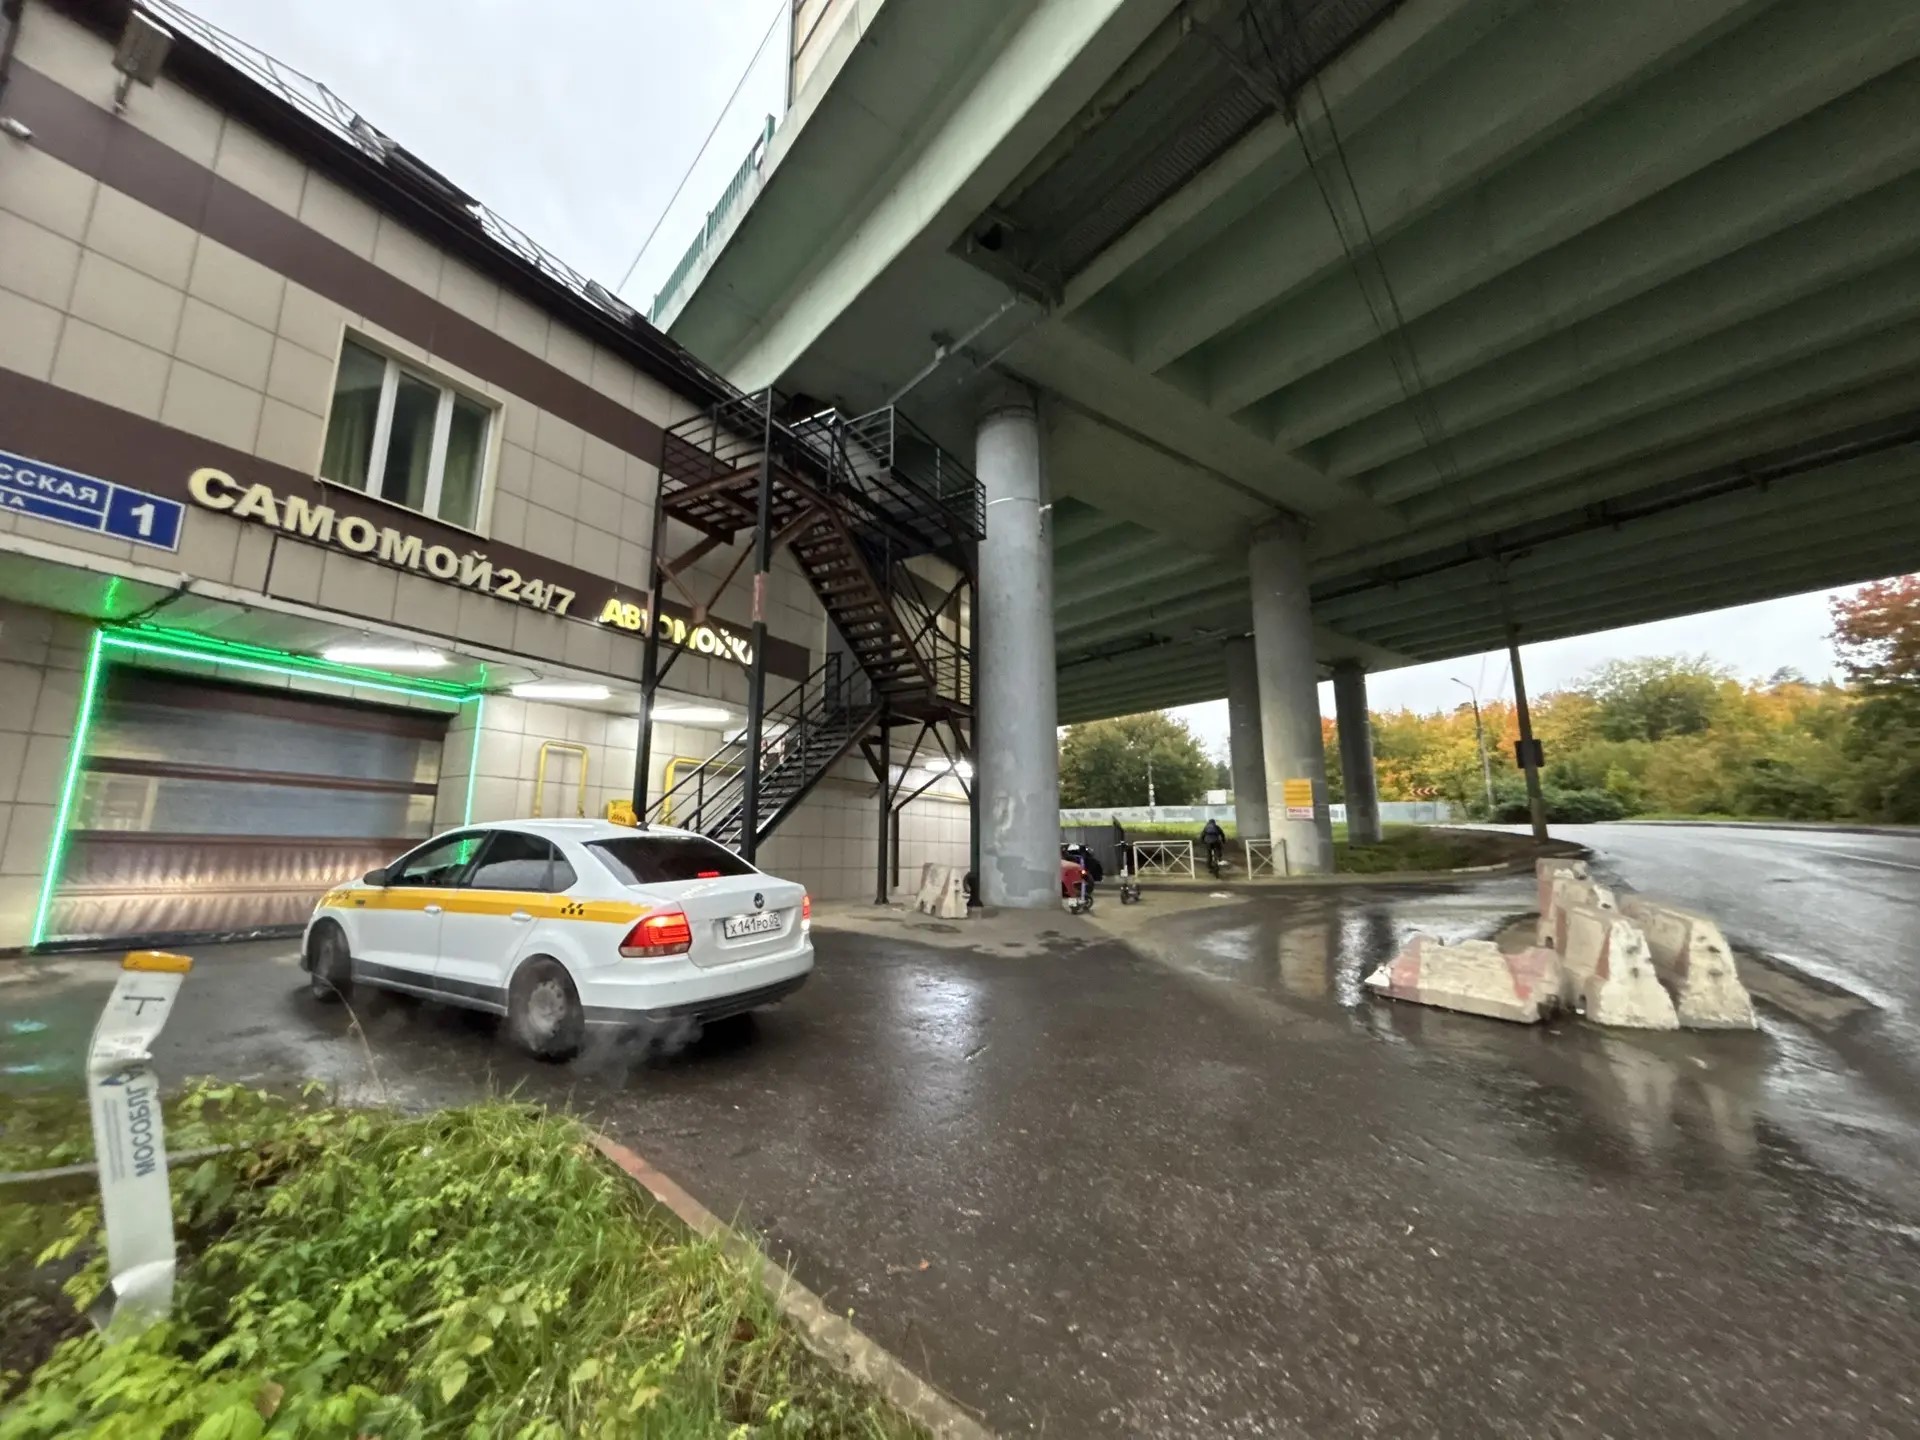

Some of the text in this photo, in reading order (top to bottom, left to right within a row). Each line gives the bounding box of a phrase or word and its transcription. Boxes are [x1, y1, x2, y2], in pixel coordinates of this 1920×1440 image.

[130, 502, 156, 537] 1
[187, 467, 576, 616] САМОМОЙ 24/7
